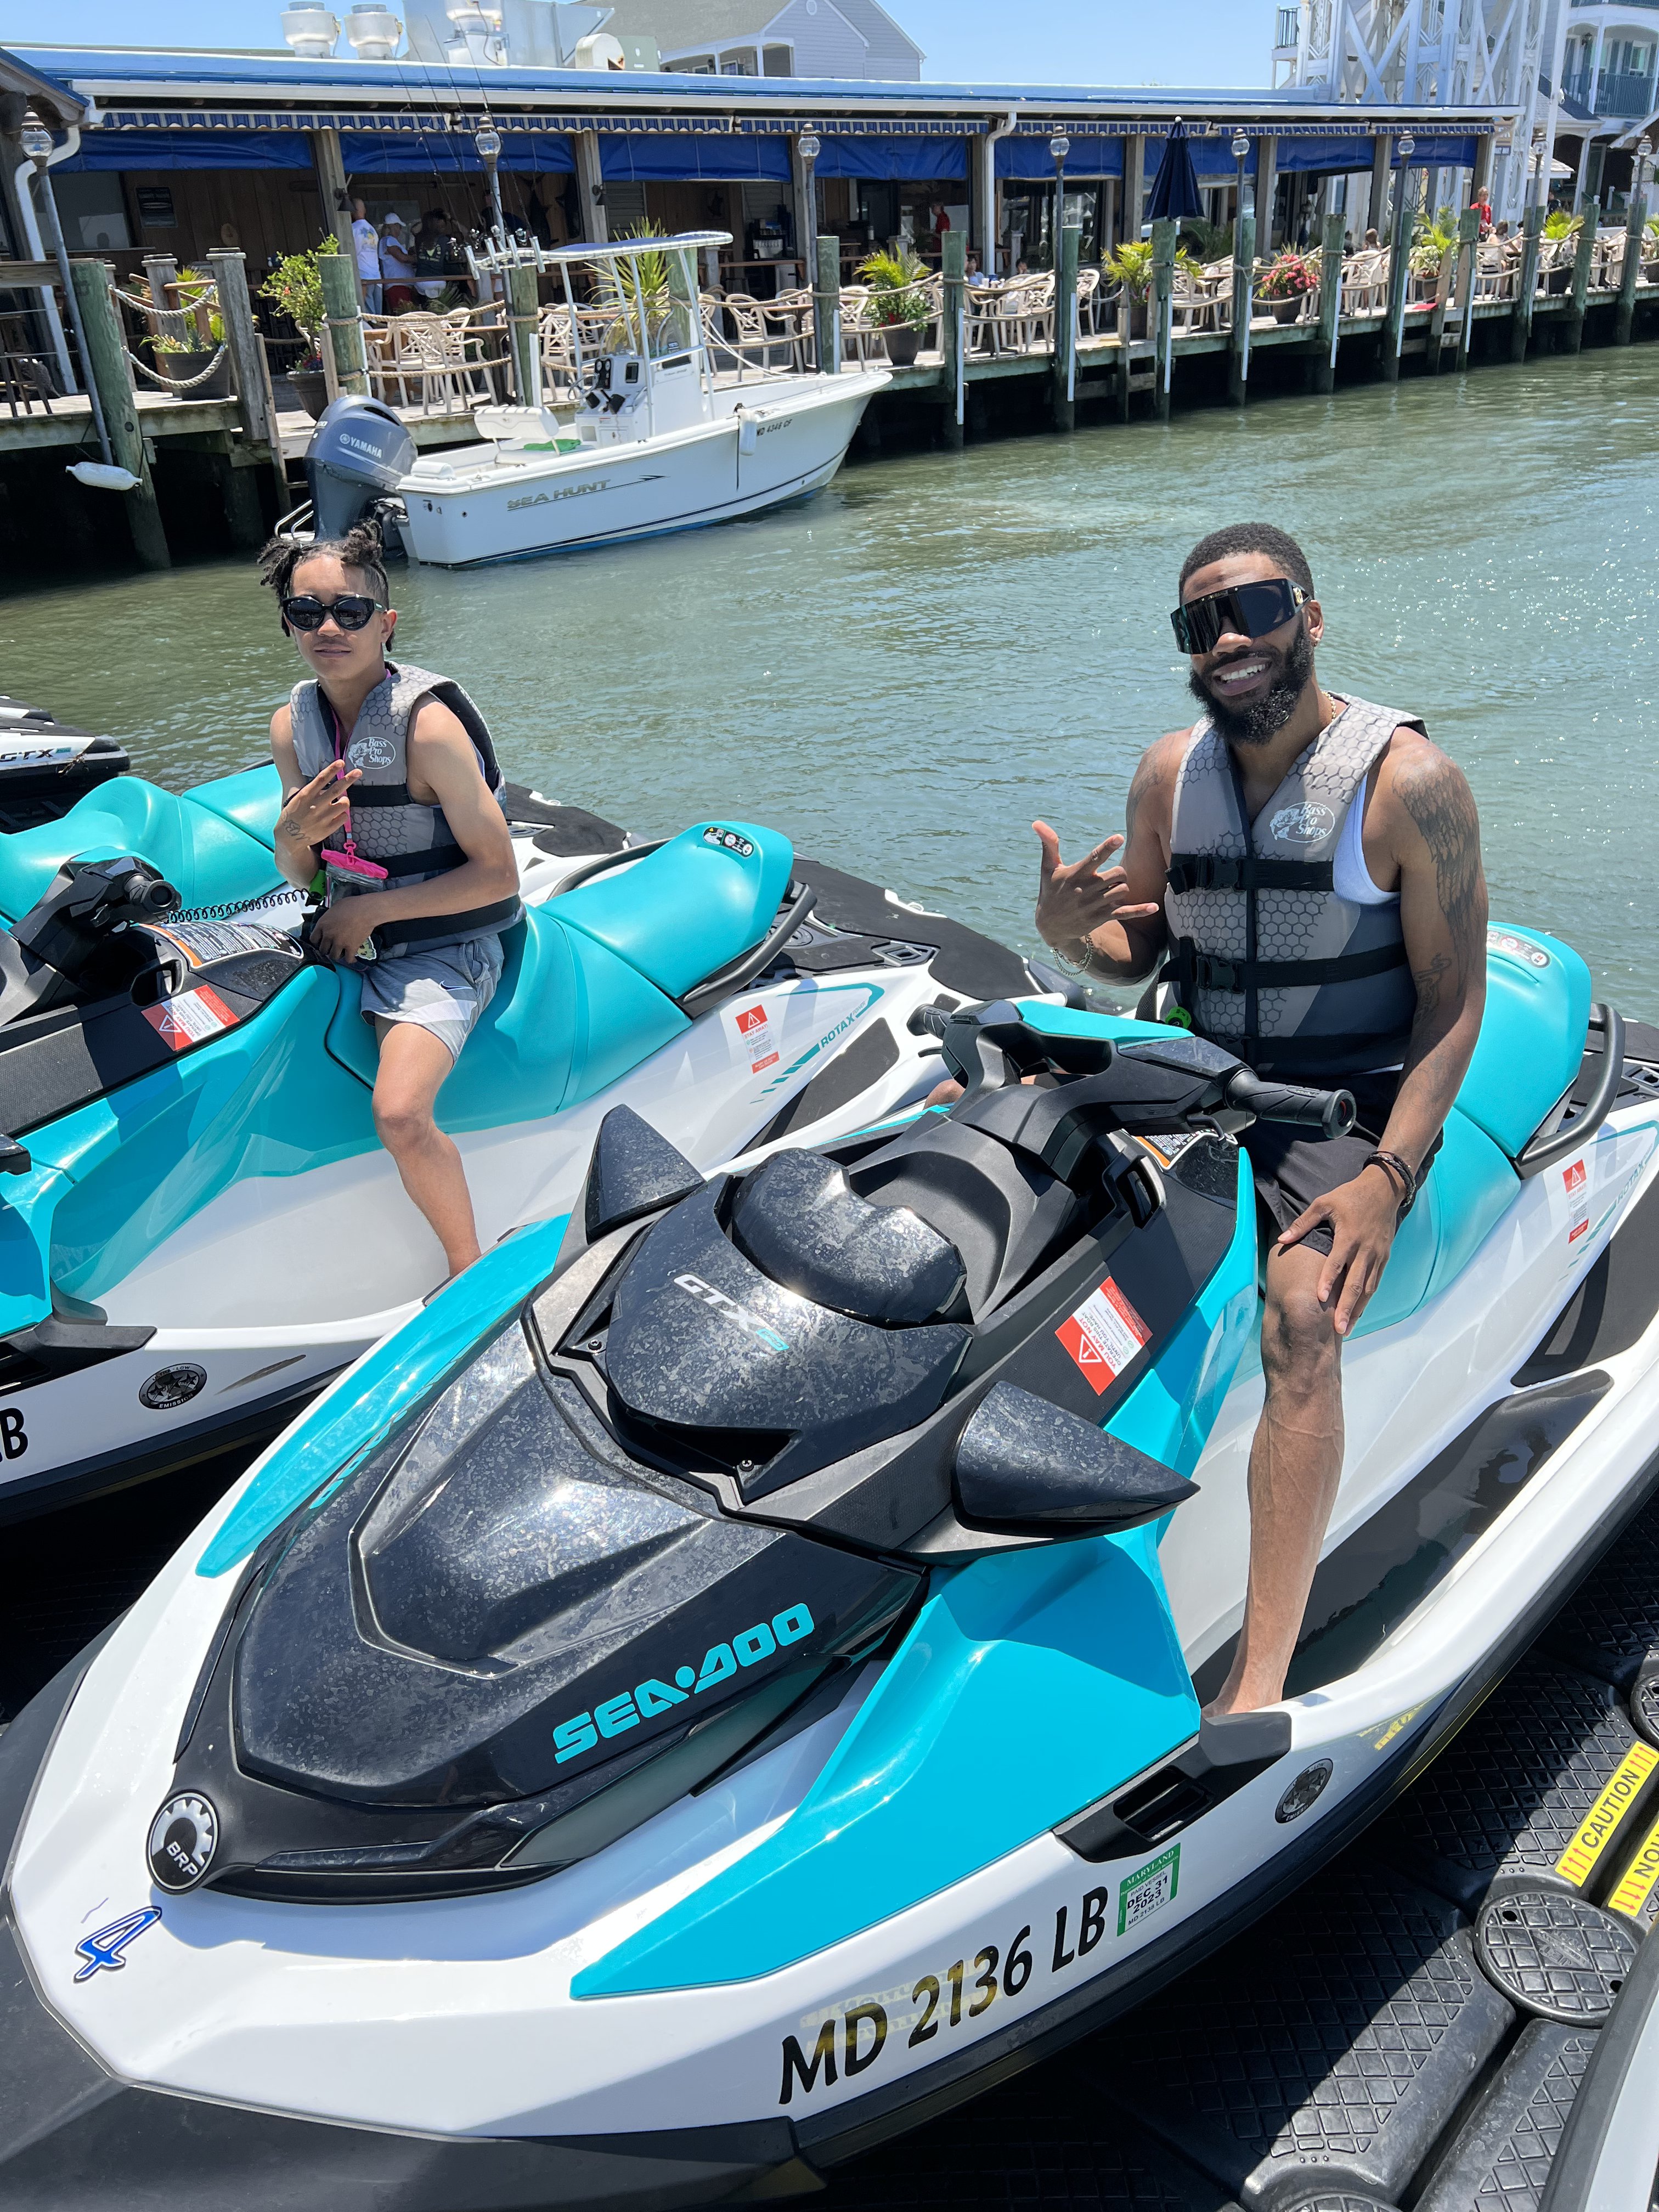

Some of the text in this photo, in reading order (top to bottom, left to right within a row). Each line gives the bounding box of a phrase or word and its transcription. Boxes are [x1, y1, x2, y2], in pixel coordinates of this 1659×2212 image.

[350, 437, 383, 459] YAMAHA
[507, 478, 611, 509] SEA HUNT
[0, 749, 54, 762] GTX
[368, 737, 387, 748] Bass
[369, 747, 382, 755] Pro
[368, 754, 392, 765] Shops
[1299, 814, 1318, 826] Pro
[1300, 803, 1327, 816] Bass
[1295, 823, 1327, 838] Shops
[184, 1026, 197, 1037] YOU
[744, 1030, 755, 1039] STAY
[820, 1013, 855, 1048] ROTAX
[1617, 1159, 1644, 1204] ROTAX
[674, 1274, 768, 1332] GTX
[1079, 1316, 1118, 1369] YOU MAY NOT
[1081, 1310, 1121, 1366] OPERATE THIS BOAT
[1099, 1329, 1110, 1342] YOU
[1108, 1341, 1121, 1358] UNTIL
[159, 1393, 194, 1408] EMISSION
[0, 1408, 29, 1463] B
[1581, 1768, 1641, 1849] CAUTION
[165, 1841, 199, 1877] BRP
[1127, 1850, 1175, 1887] MARYLAND
[1127, 1875, 1168, 1910] DEC 31
[1130, 1870, 1166, 1897] PAID VESSEL
[1128, 1915, 1138, 1926] MD
[1156, 1897, 1165, 1906] LB
[1133, 1889, 1162, 1914] 2023
[73, 1905, 162, 1984] 4
[778, 1886, 1108, 2104] MD 2136 LB
